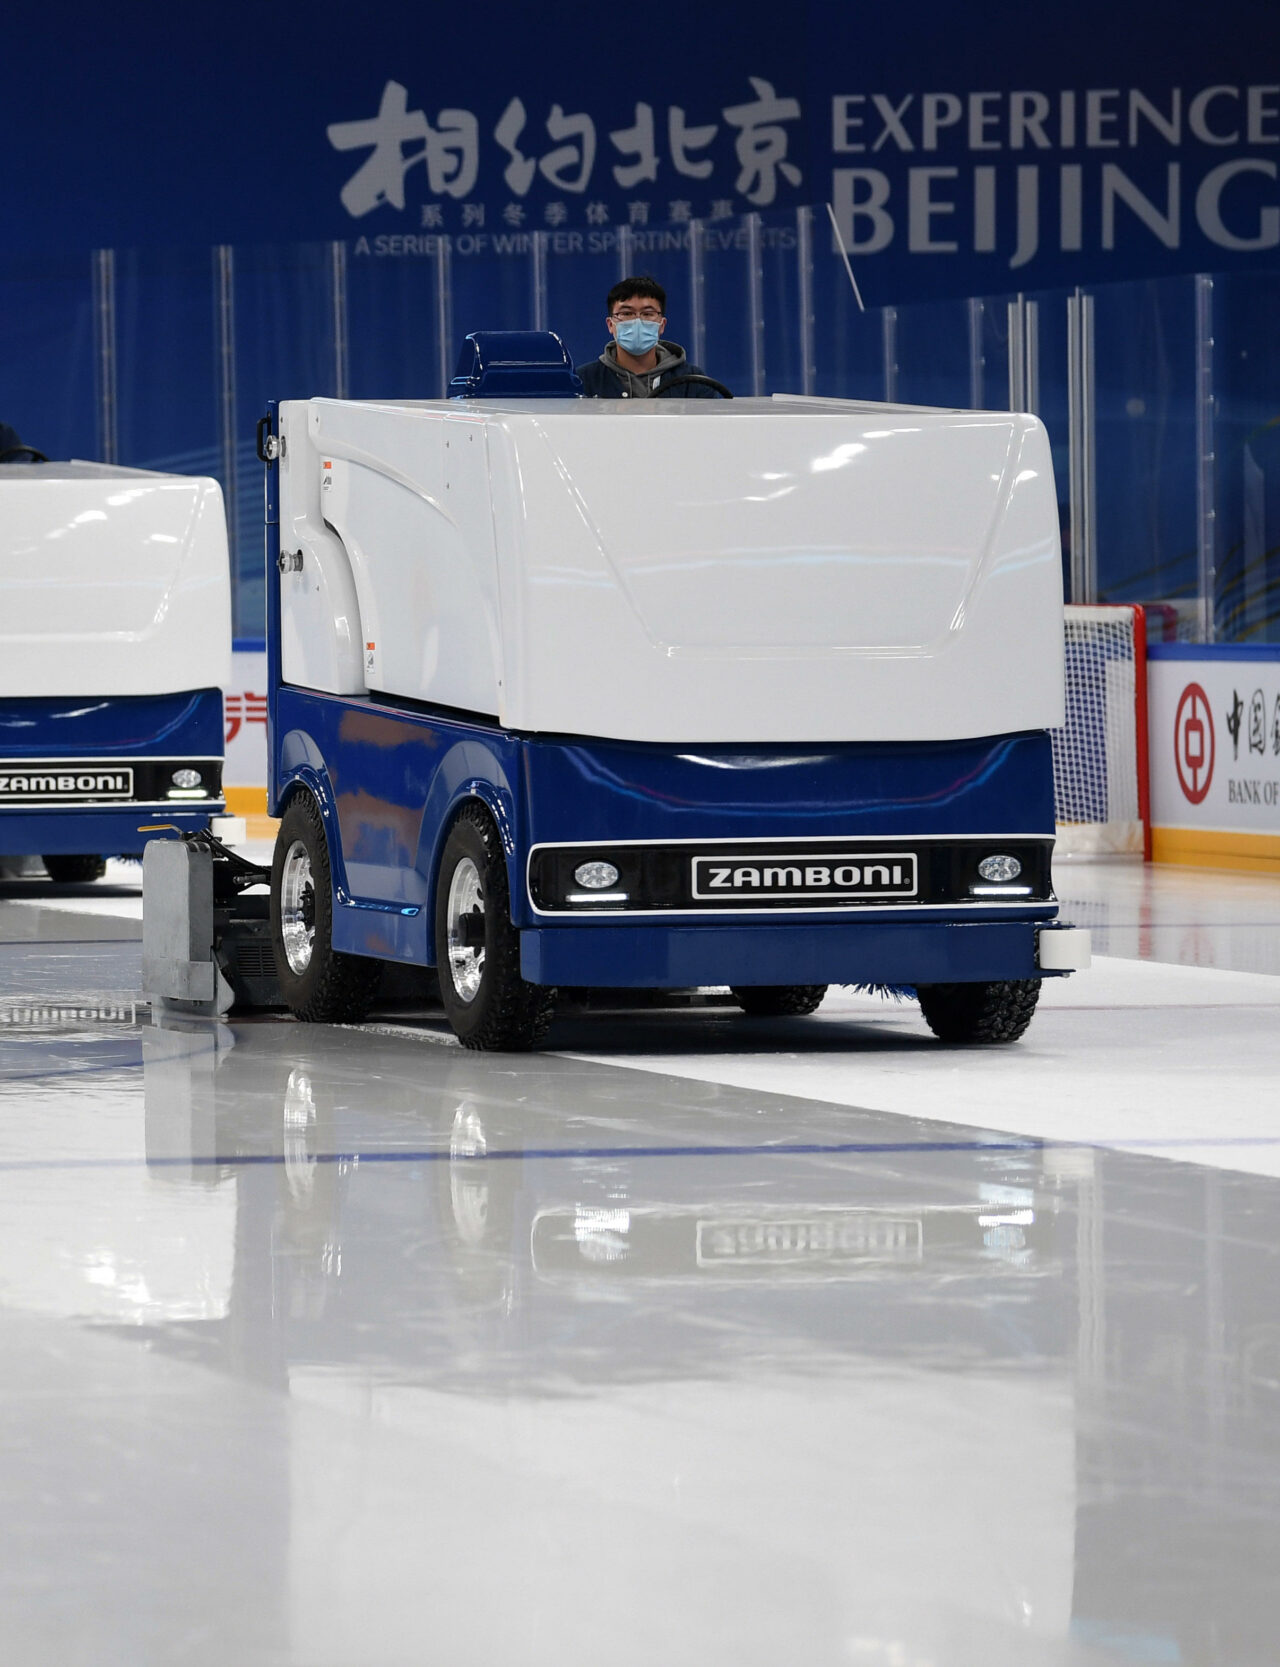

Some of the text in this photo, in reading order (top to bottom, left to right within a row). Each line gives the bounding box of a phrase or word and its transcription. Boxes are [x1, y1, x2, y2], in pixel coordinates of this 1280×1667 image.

[832, 86, 1280, 152] EXPERIENCE
[327, 76, 803, 218] 相约北京
[832, 158, 1280, 268] BEIJING
[355, 235, 370, 256] A
[456, 233, 488, 254] OF
[1228, 780, 1279, 805] BANK OF
[708, 864, 903, 888] ZAMBONI
